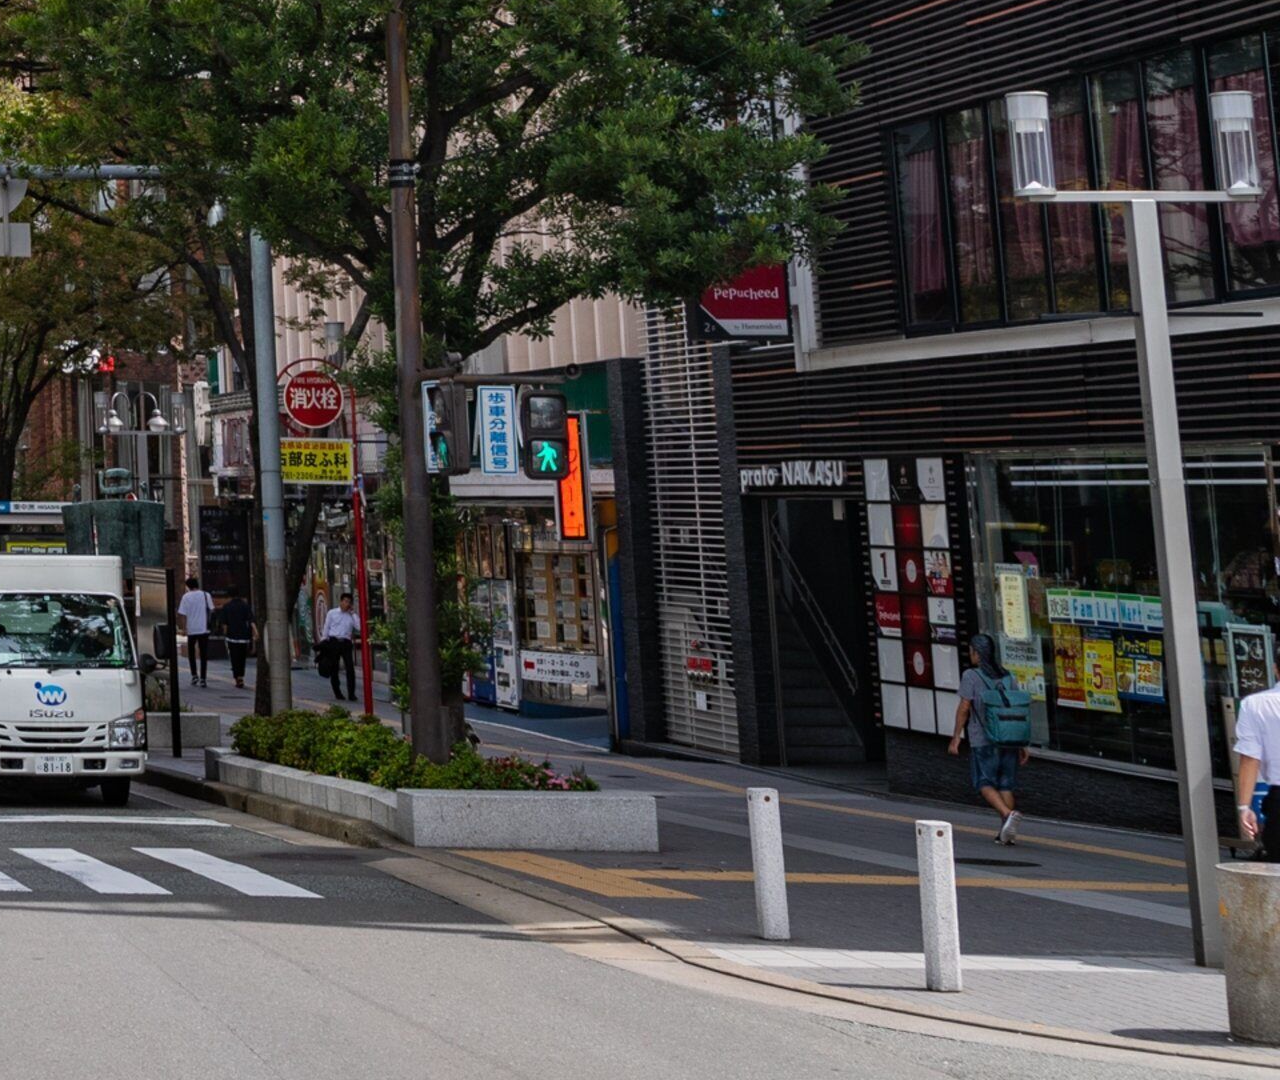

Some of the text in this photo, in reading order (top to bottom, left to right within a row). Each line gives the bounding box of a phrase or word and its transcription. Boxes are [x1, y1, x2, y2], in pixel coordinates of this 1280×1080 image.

[290, 387, 338, 409] 消火栓
[487, 392, 508, 469] 歩車分離信号
[781, 461, 844, 487] NAKASU
[1072, 598, 1117, 621] Family
[29, 709, 74, 718] ISUZU
